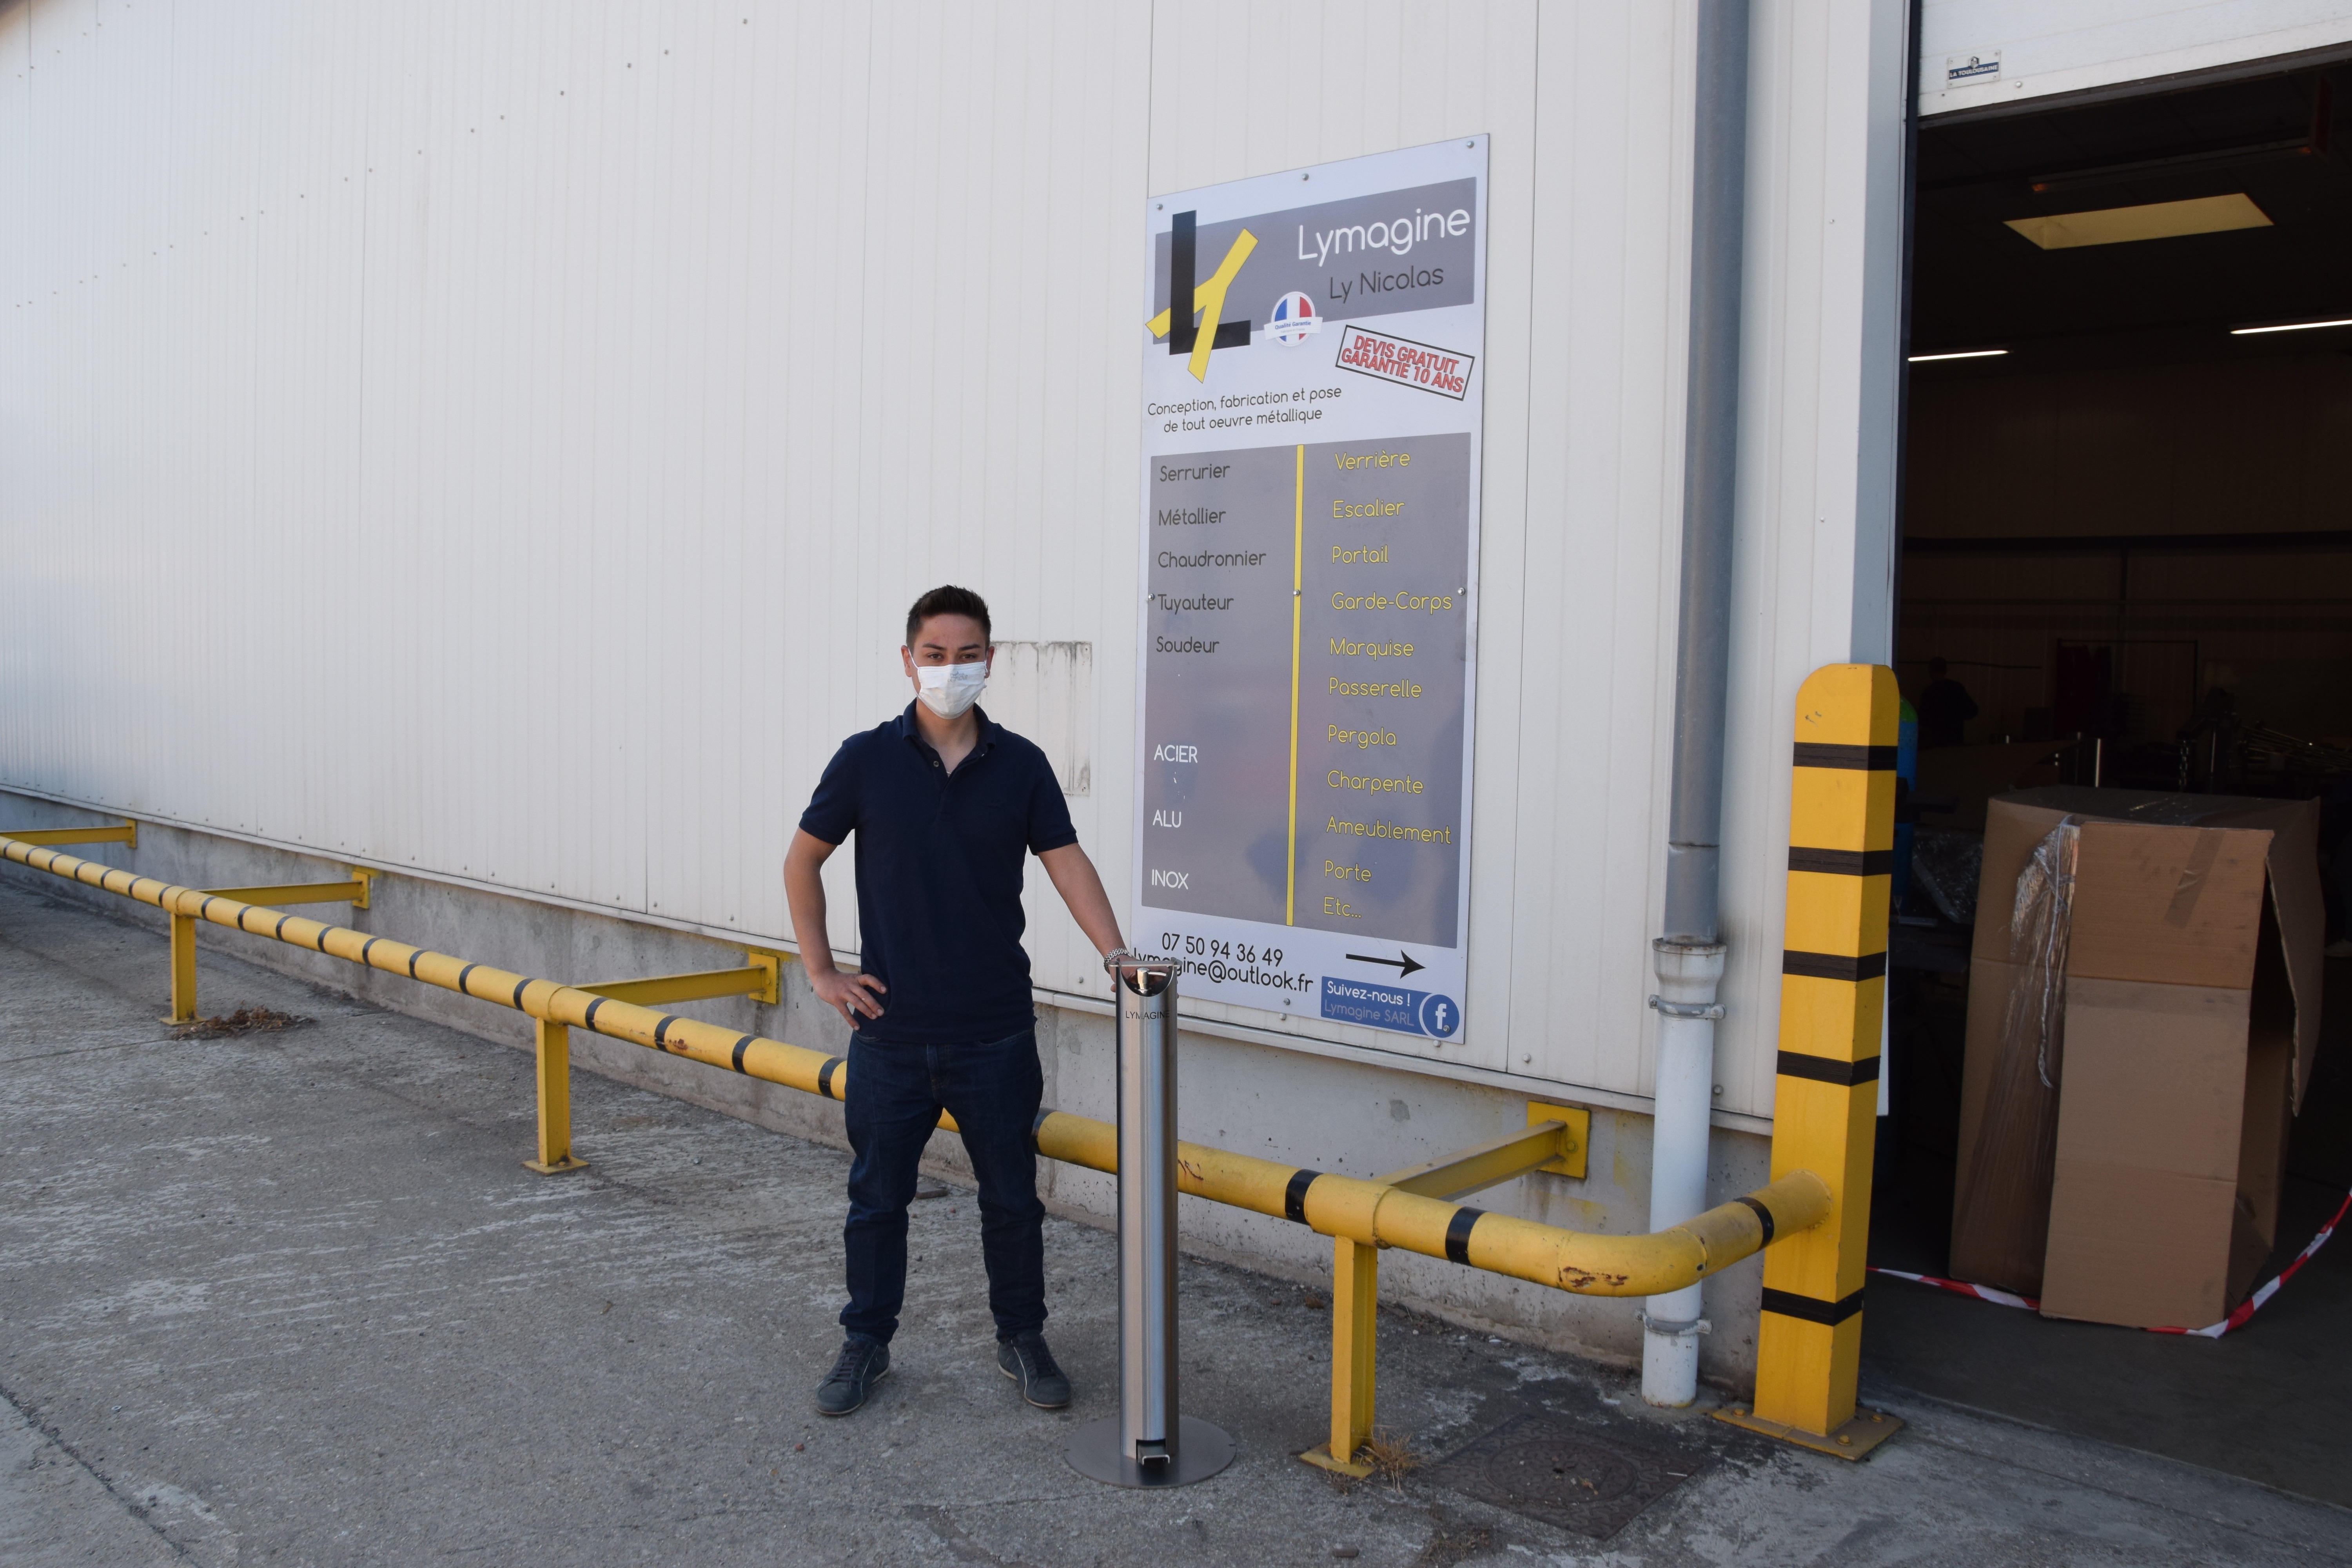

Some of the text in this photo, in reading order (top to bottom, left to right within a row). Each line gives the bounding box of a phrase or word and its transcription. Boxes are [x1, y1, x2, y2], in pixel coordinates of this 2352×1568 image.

[1959, 65, 1998, 75] TOULOUSAINE
[1298, 208, 1470, 267] Lymagine
[1330, 265, 1444, 304] Ly Nicolas
[1354, 335, 1459, 374] DEVIS GRATUIT
[1341, 348, 1464, 392] GARANTIE 10 ANS
[1147, 387, 1342, 416] Conception, fabrication et pose
[1164, 408, 1322, 433] de tout oeuvre métallique
[1335, 449, 1411, 471] Verrière
[1159, 463, 1231, 483] Serrurier
[1159, 507, 1226, 526] Métallier
[1333, 498, 1405, 519] Escalier
[1158, 550, 1267, 568] Chaudronnier
[1332, 544, 1389, 564] Portail
[1157, 593, 1234, 615] Tuyauteur
[1331, 590, 1453, 615] Garde-Corps
[1156, 636, 1220, 653] Soudeur
[1330, 637, 1415, 662] Marquise
[1329, 676, 1422, 699] Passerelle
[1328, 724, 1397, 750] Pergola
[1154, 744, 1198, 763] ACIER
[1327, 769, 1424, 797] Charpente
[1152, 809, 1181, 828] ALU
[1325, 815, 1452, 845] Ameublement
[1152, 869, 1189, 890] INOX
[1325, 859, 1372, 883] Porte
[1323, 895, 1362, 919] Etc...
[1161, 932, 1283, 967] 07 50 94 36 49
[1134, 947, 1313, 993] lymine@outlook.fr
[1327, 981, 1410, 1006] Suivez-nous !
[1125, 1011, 1170, 1019] LYMAGINE
[1325, 1000, 1414, 1026] Lymagine SARL
